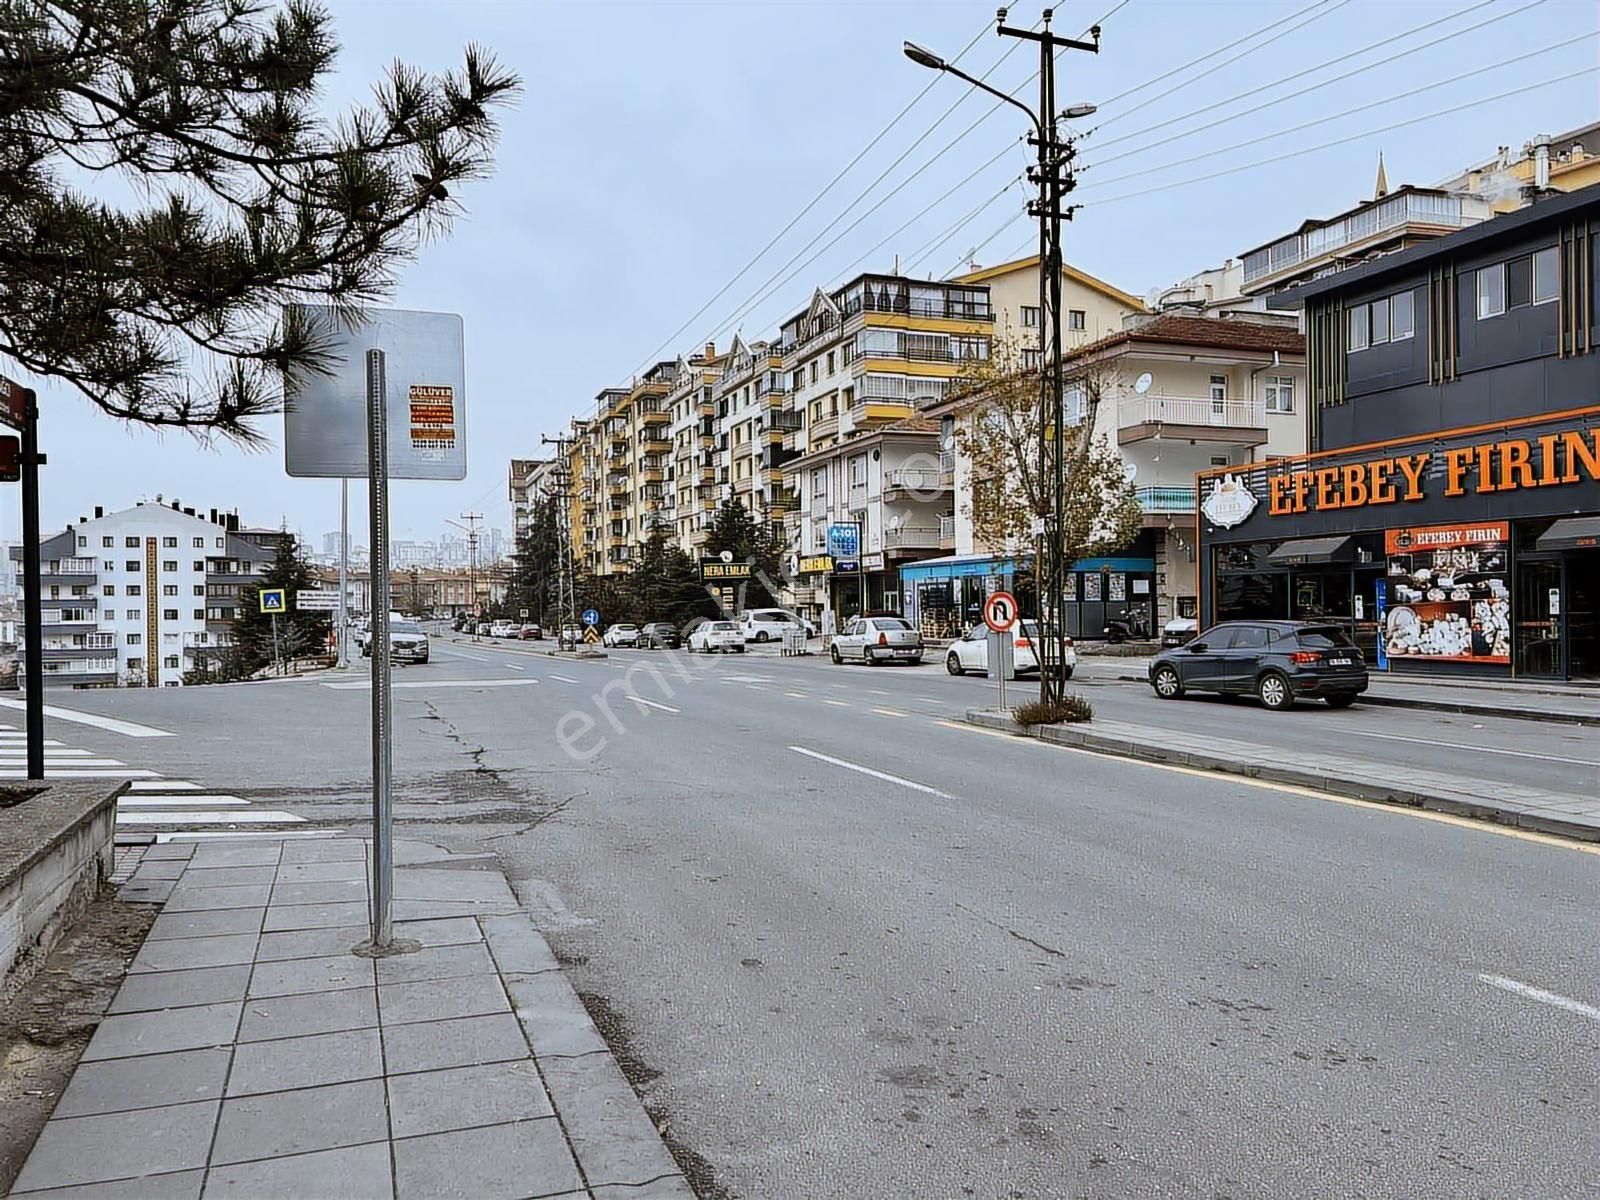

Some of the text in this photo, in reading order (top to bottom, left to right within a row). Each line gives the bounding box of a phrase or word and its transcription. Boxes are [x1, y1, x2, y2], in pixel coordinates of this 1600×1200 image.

[1268, 427, 1600, 515] EFEBEY FIRIN
[1417, 530, 1462, 545] EFEBEY
[1465, 528, 1501, 542] FIRIN
